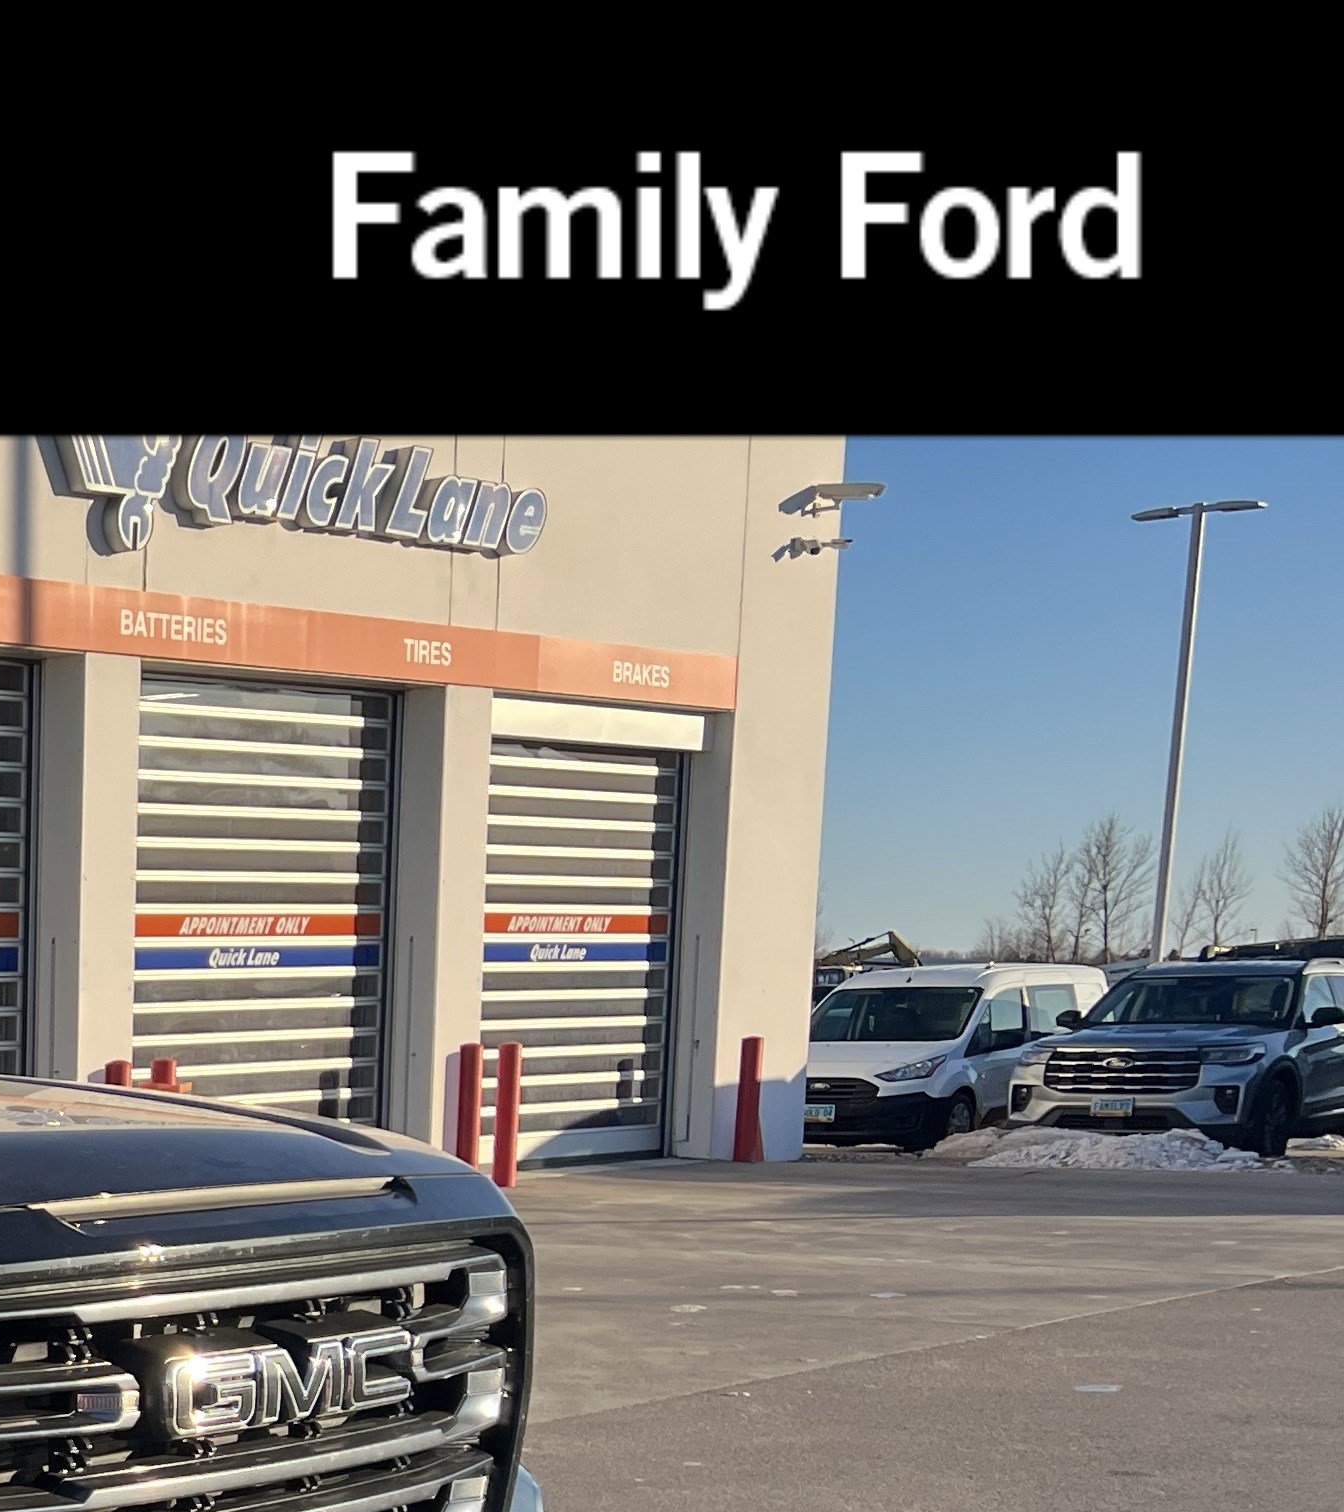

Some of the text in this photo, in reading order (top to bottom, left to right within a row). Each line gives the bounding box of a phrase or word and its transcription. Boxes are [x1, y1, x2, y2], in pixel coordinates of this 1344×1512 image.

[120, 609, 227, 646] BATTERIES
[403, 637, 452, 667] TIRES
[613, 660, 670, 688] BRAKES
[179, 915, 311, 936] APPOINTMENT ONLY
[507, 915, 612, 933] APPOINTMENT ONLY
[170, 1327, 414, 1439] GMC
